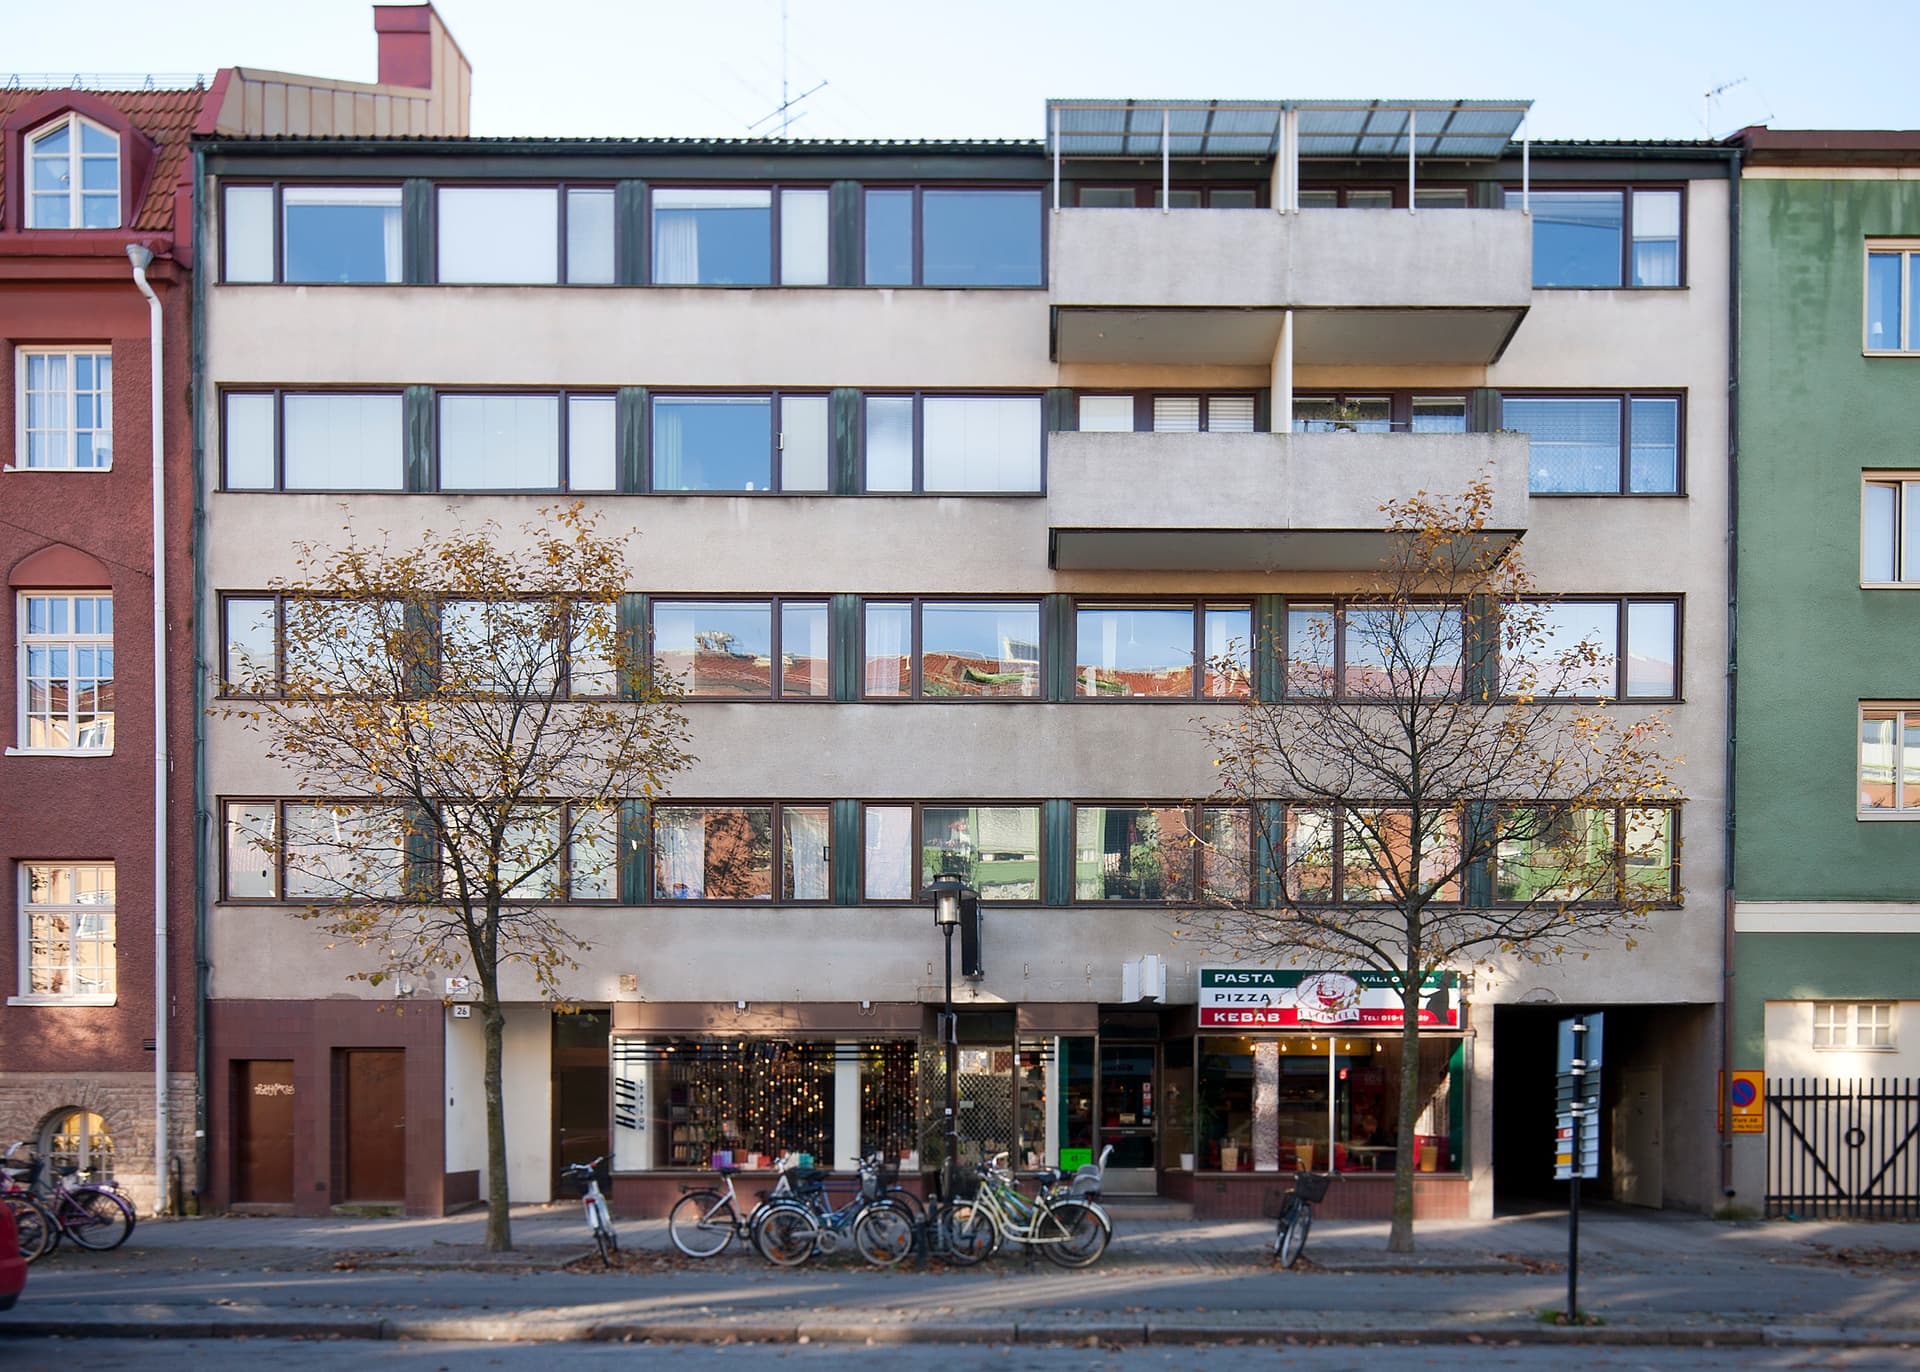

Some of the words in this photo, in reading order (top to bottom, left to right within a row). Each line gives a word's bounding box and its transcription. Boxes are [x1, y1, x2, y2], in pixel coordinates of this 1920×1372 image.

[1214, 973, 1275, 983] PASTA
[1215, 993, 1271, 1002] PIZZA
[457, 1007, 468, 1016] 26
[1214, 1012, 1280, 1022] KEBAB
[615, 1077, 636, 1130] HAIR
